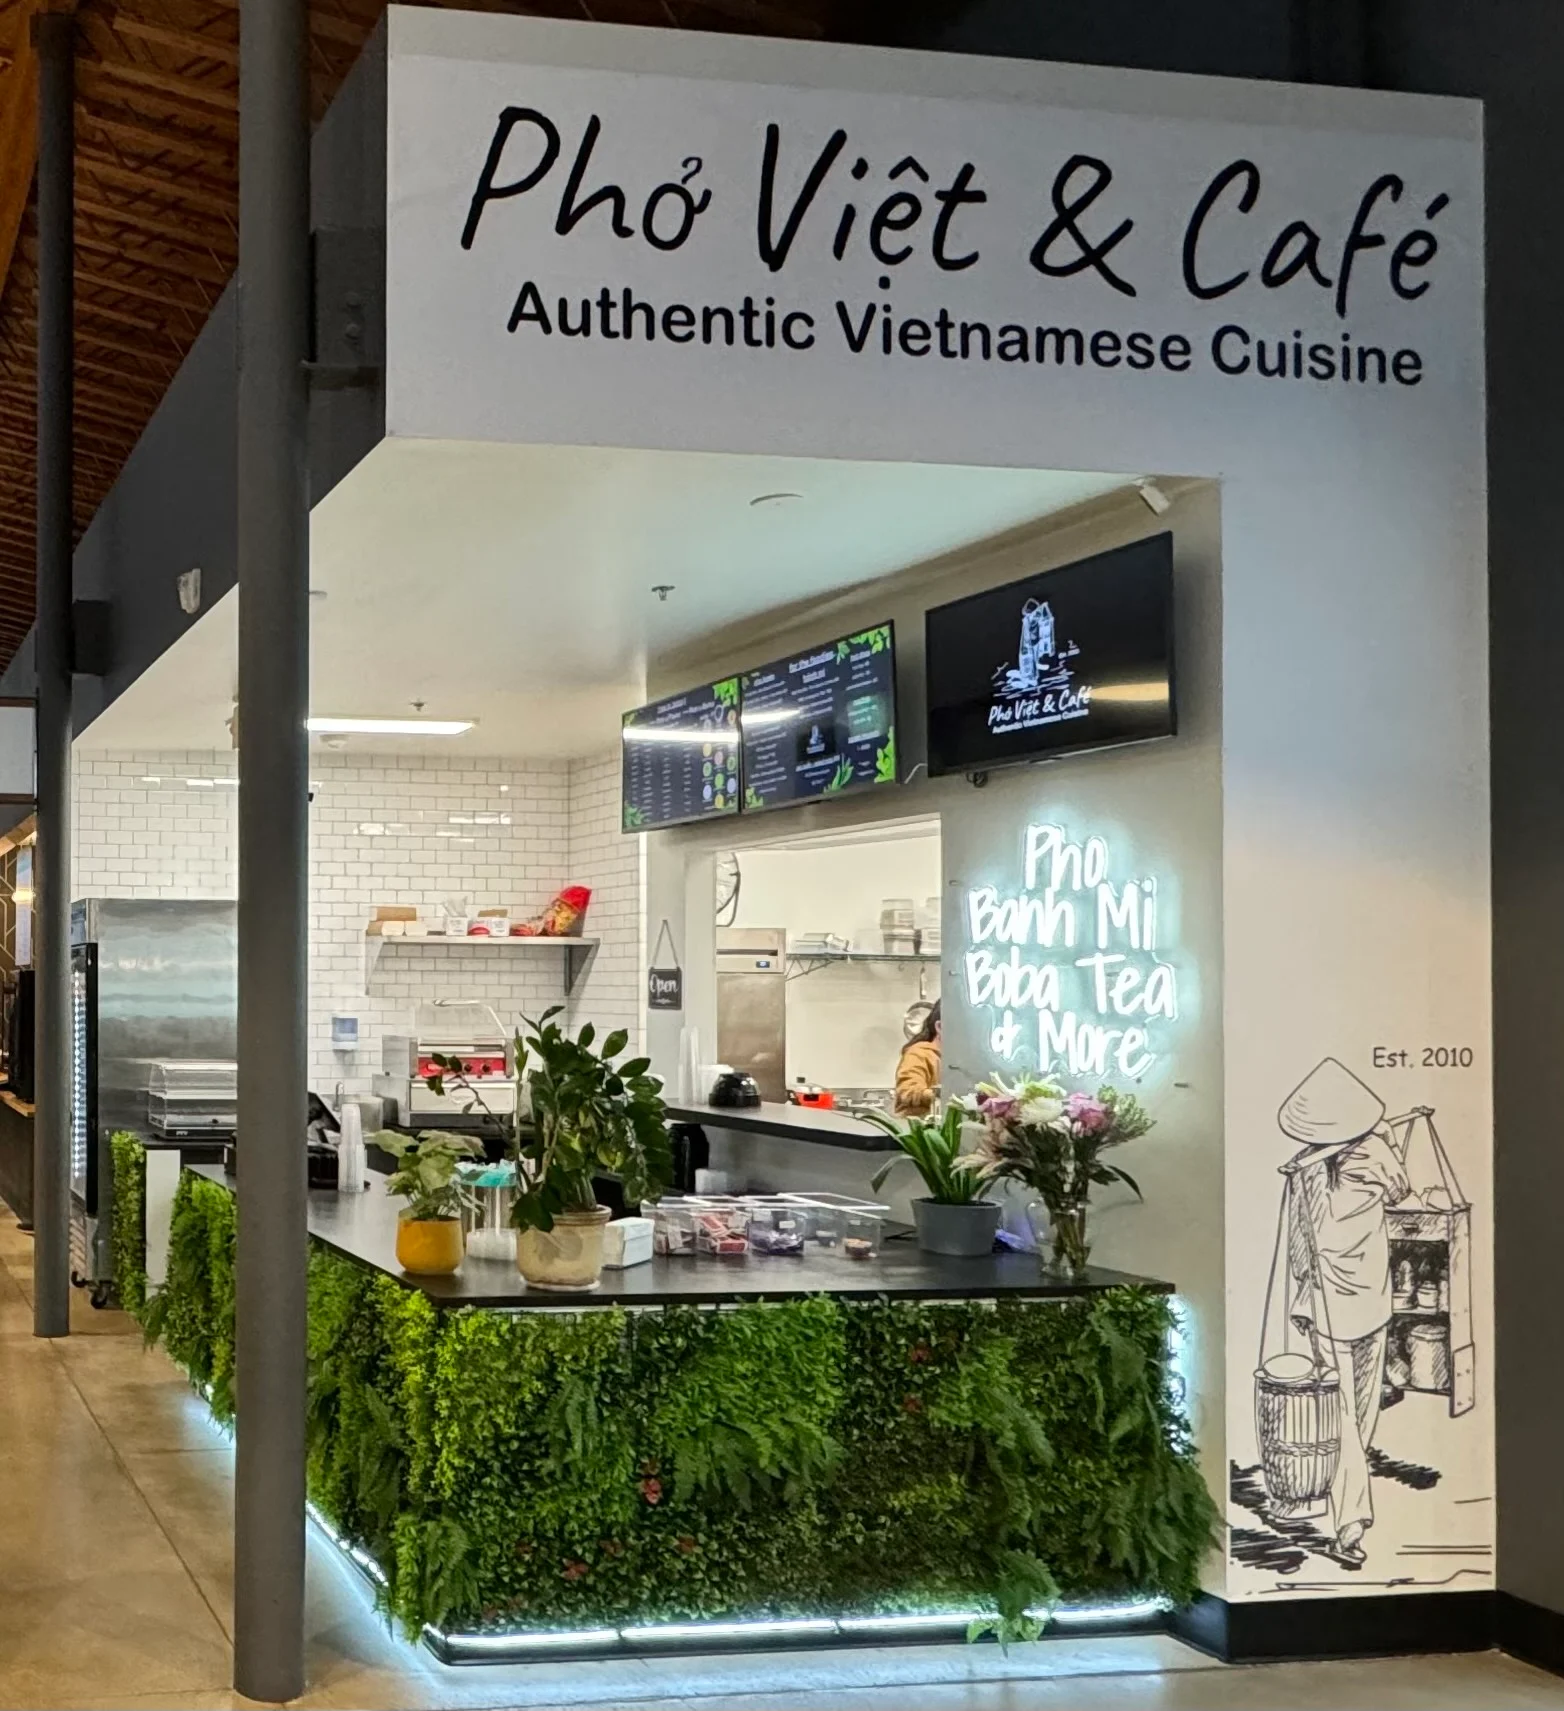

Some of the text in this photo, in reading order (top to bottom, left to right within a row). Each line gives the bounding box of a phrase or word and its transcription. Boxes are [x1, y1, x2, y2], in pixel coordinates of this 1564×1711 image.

[461, 106, 1451, 320] Phở Việt & Café
[507, 281, 1423, 386] Authentic Vietnamese Cuisine
[1042, 693, 1057, 713] &
[1024, 823, 1108, 892] Pho
[968, 876, 1156, 951] Banh Mi
[649, 973, 680, 998] Open
[965, 945, 1176, 1019] Boba Tea
[990, 1008, 1155, 1077] & More
[1373, 1046, 1474, 1069] Est. 2010
